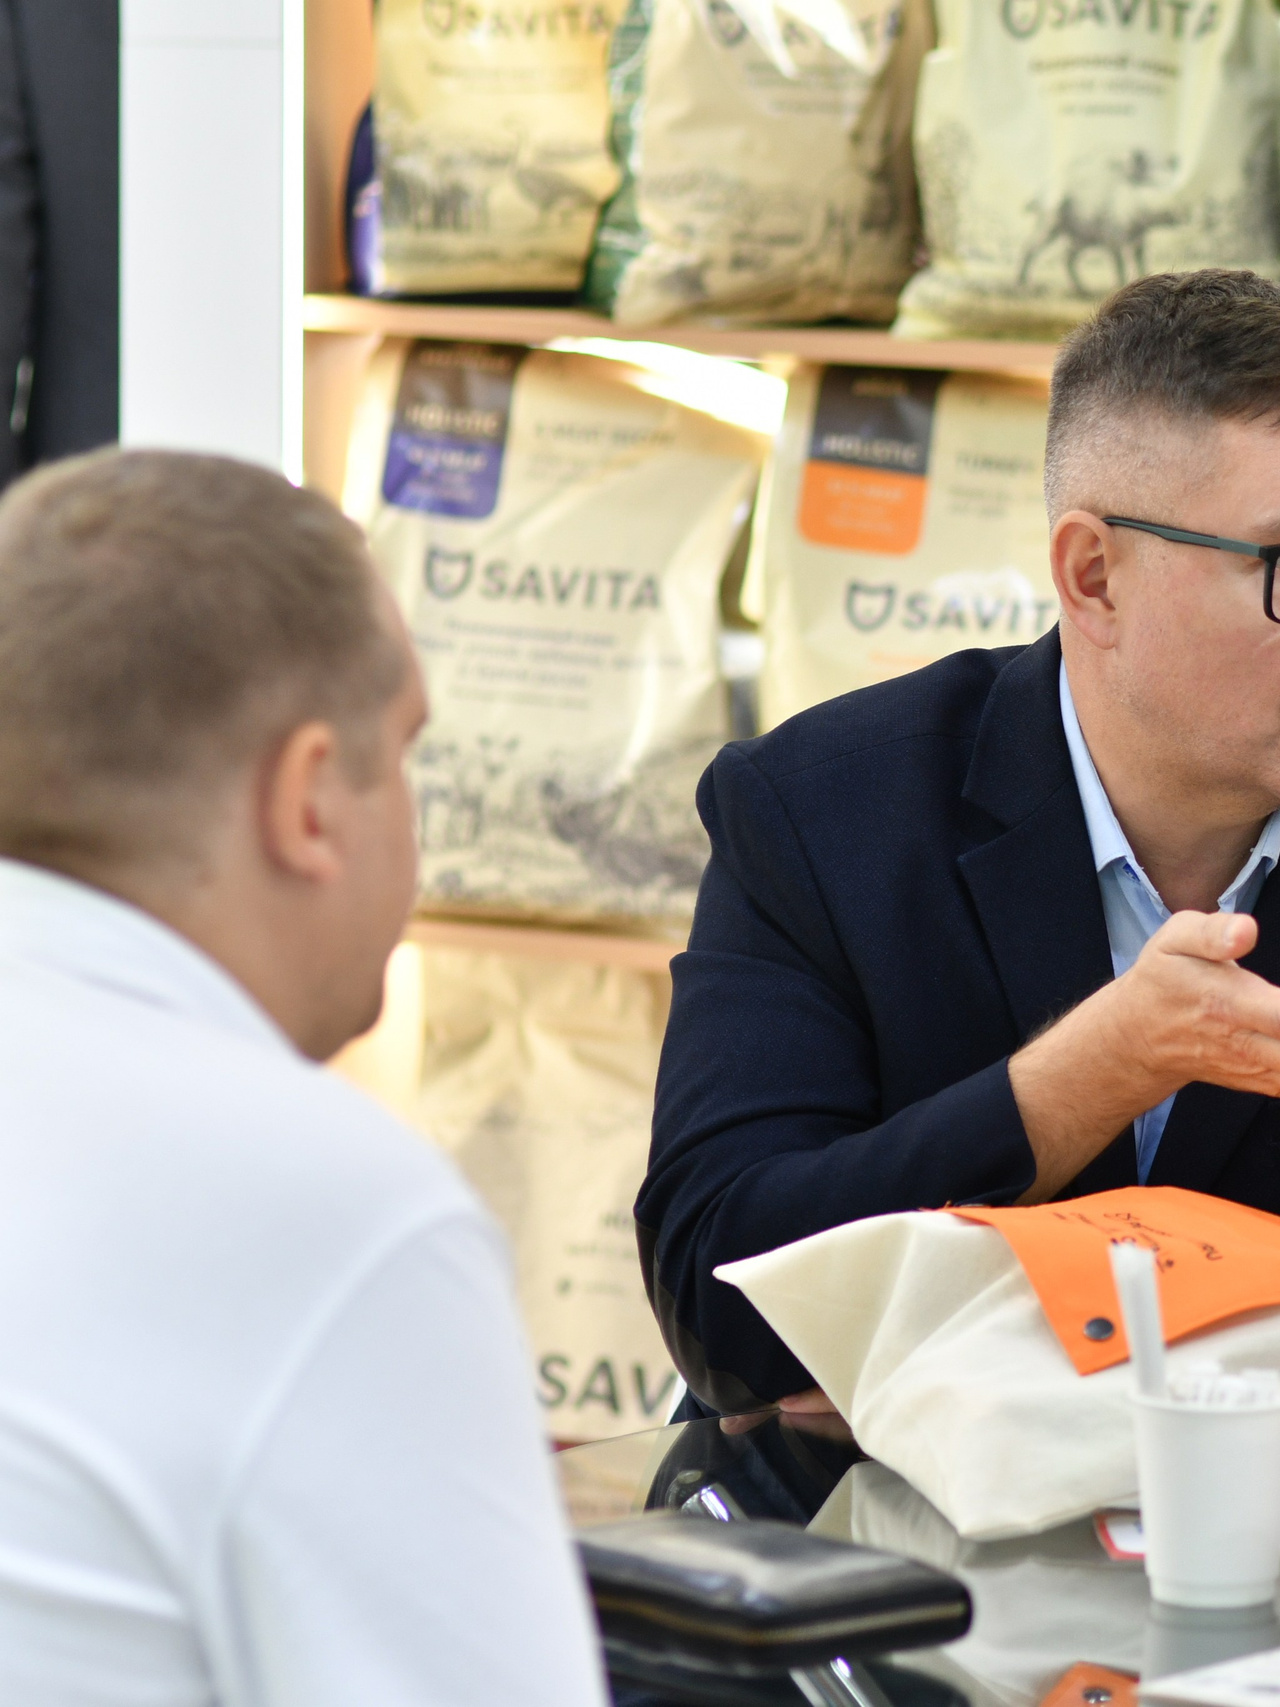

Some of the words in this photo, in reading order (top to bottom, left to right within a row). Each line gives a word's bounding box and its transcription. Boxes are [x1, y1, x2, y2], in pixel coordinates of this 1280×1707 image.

[477, 560, 662, 611] SAVITA
[902, 589, 1059, 634] SAVIT
[536, 1353, 681, 1418] SAV
